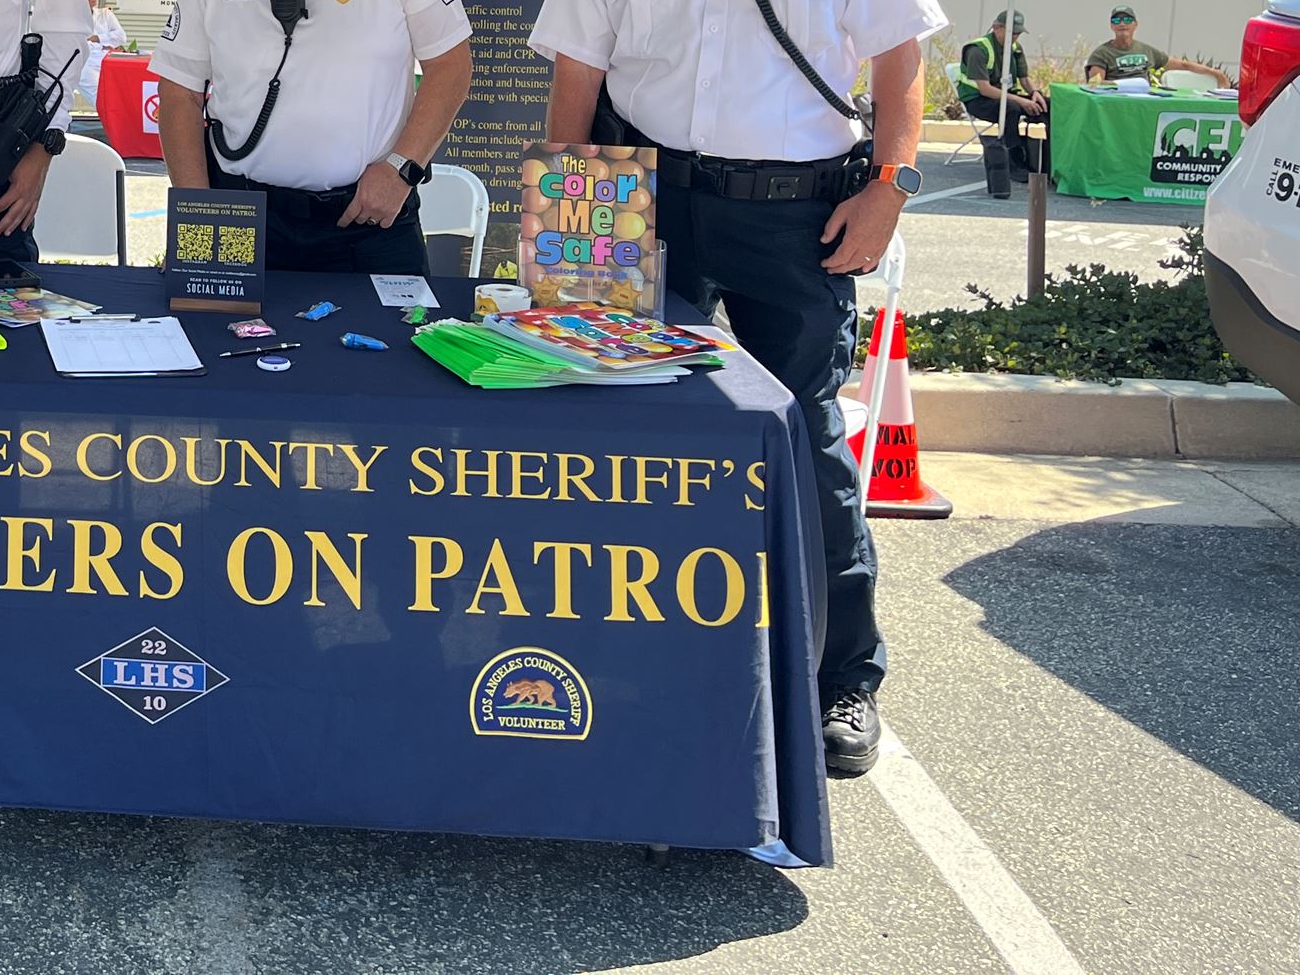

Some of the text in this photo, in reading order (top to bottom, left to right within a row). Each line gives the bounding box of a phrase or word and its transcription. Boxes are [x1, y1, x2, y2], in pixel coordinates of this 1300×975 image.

[490, 5, 523, 16] control
[495, 49, 535, 60] and CPR
[492, 64, 549, 75] enforcement
[496, 78, 513, 88] and
[497, 92, 518, 103] with
[505, 120, 528, 131] from
[465, 134, 487, 143] team
[1163, 117, 1247, 159] CE
[462, 148, 503, 159] members
[561, 155, 586, 174] The
[1156, 161, 1222, 173] COMMUNITY
[1266, 170, 1279, 196] CALL
[176, 206, 220, 215] VOLUNTEERS
[232, 209, 257, 217] PATROL
[558, 199, 614, 235] Me
[535, 230, 641, 267] Safe
[186, 283, 245, 296] SOCIAL MEDIA
[77, 432, 389, 493] COUNTY
[409, 445, 766, 511] SHERIFF'S
[226, 526, 368, 611] ON
[141, 639, 167, 655] 22
[113, 661, 195, 689] LHS
[481, 656, 581, 727] LOS ANGELES COUNTY SHERIFF
[143, 695, 167, 711] 10
[498, 716, 566, 731] VOLUNTEER
